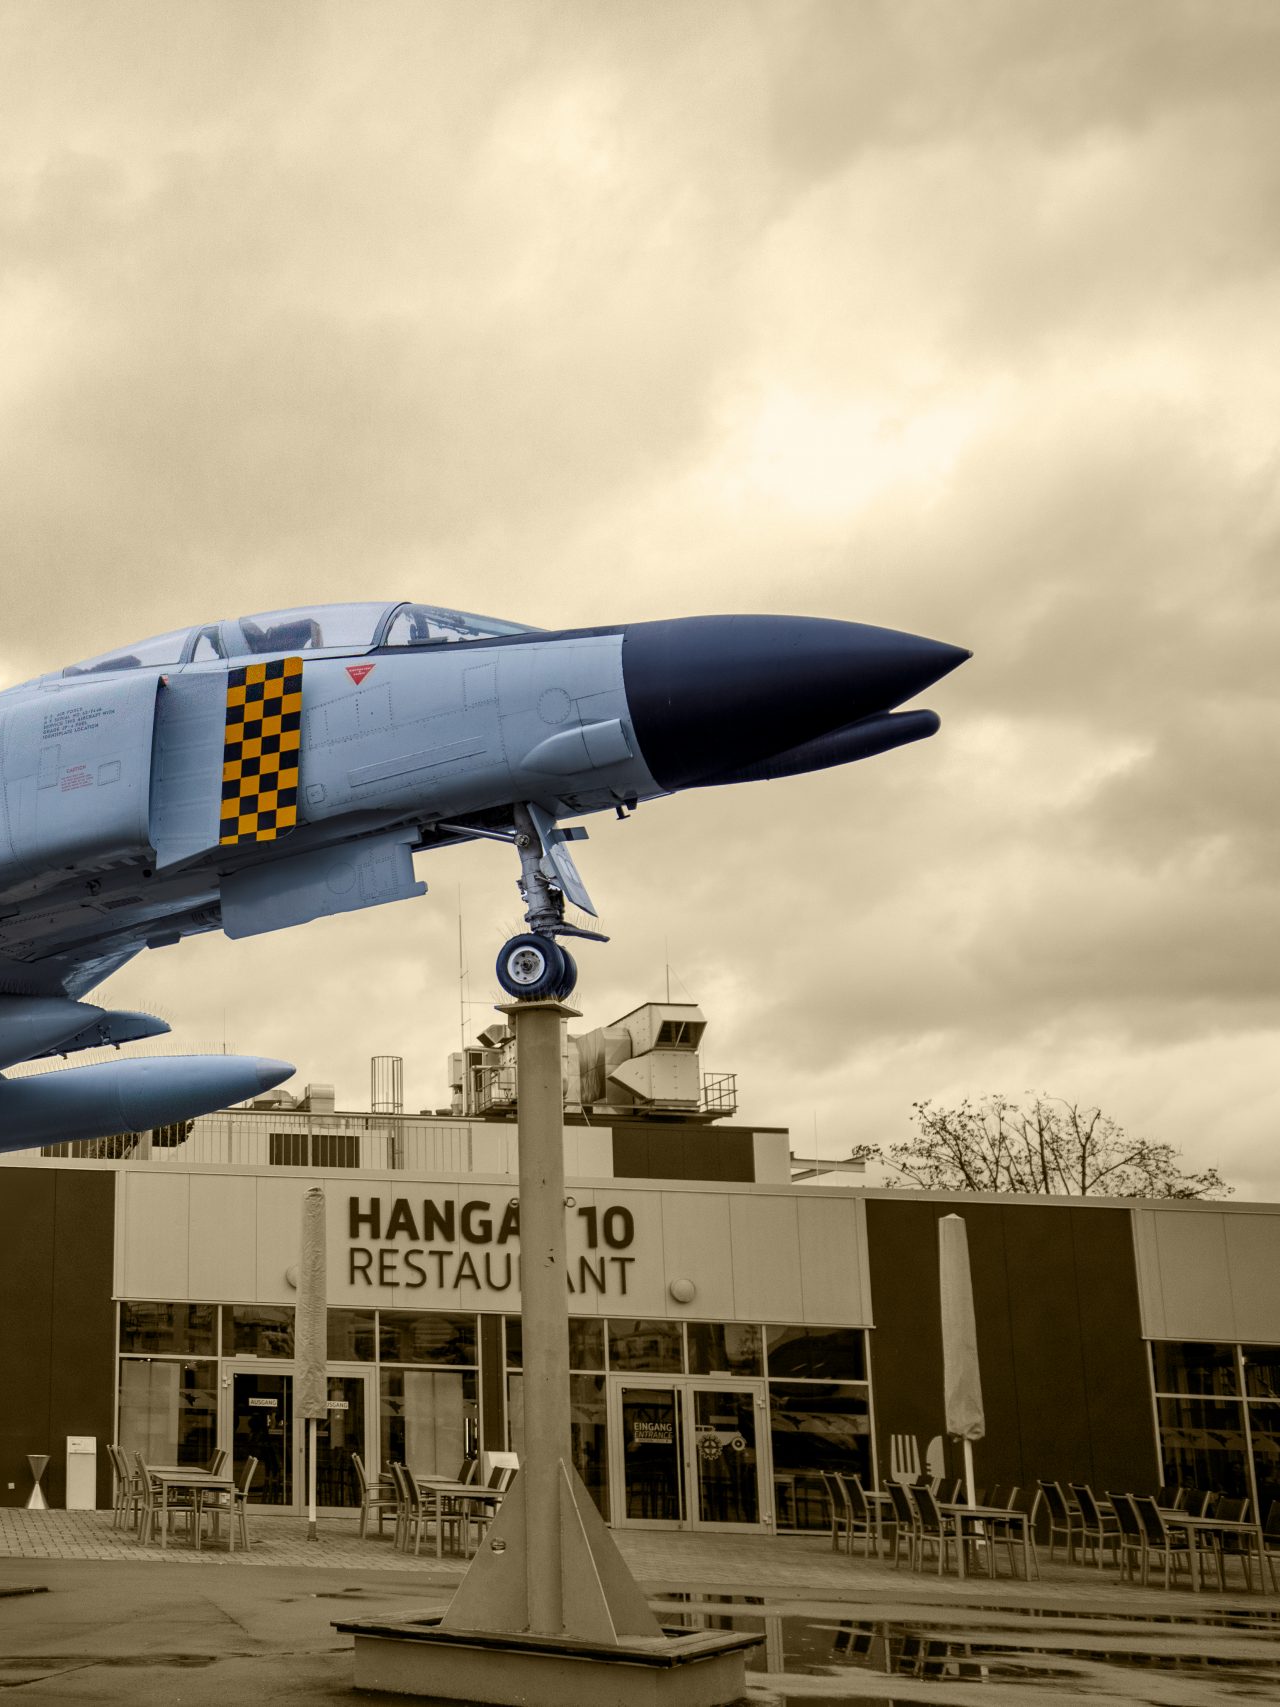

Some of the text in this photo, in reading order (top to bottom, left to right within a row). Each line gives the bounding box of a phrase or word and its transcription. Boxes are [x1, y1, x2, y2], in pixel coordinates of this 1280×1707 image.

[349, 1196, 635, 1250] HANGA 10
[349, 1247, 636, 1295] RESTAUNT
[634, 1422, 672, 1431] EINGANG
[634, 1431, 673, 1439] ENTRANCE
